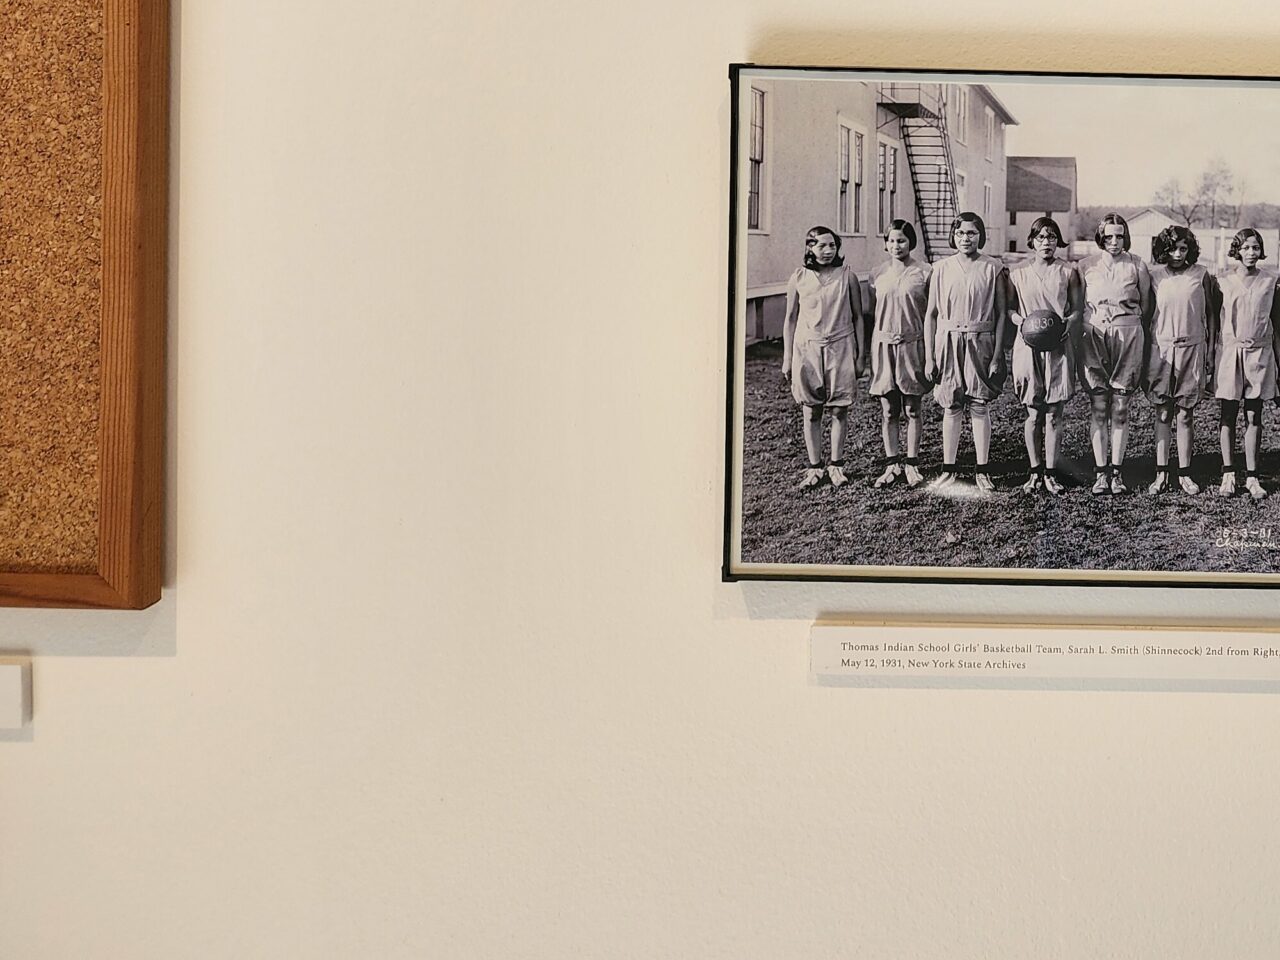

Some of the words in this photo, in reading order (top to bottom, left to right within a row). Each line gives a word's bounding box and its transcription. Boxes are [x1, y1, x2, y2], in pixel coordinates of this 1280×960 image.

[840, 641, 879, 651] Thomas
[883, 641, 914, 652] Indian
[917, 642, 950, 652] School
[983, 643, 1032, 653] Basketball
[1035, 644, 1064, 655] Team,
[1067, 644, 1094, 654] Sarah
[1098, 645, 1107, 654] L.
[1110, 644, 1139, 655] Smith
[1142, 645, 1203, 656] (Shinnecock)
[1205, 645, 1223, 656] 2nd
[1226, 646, 1249, 656] from
[1252, 646, 1280, 659] Right,
[840, 658, 861, 669] May
[864, 657, 877, 669] 12,
[880, 658, 905, 669] 1931,
[907, 658, 930, 668] New
[931, 658, 955, 668] York
[957, 659, 982, 668] State
[984, 658, 1026, 669] Archives
